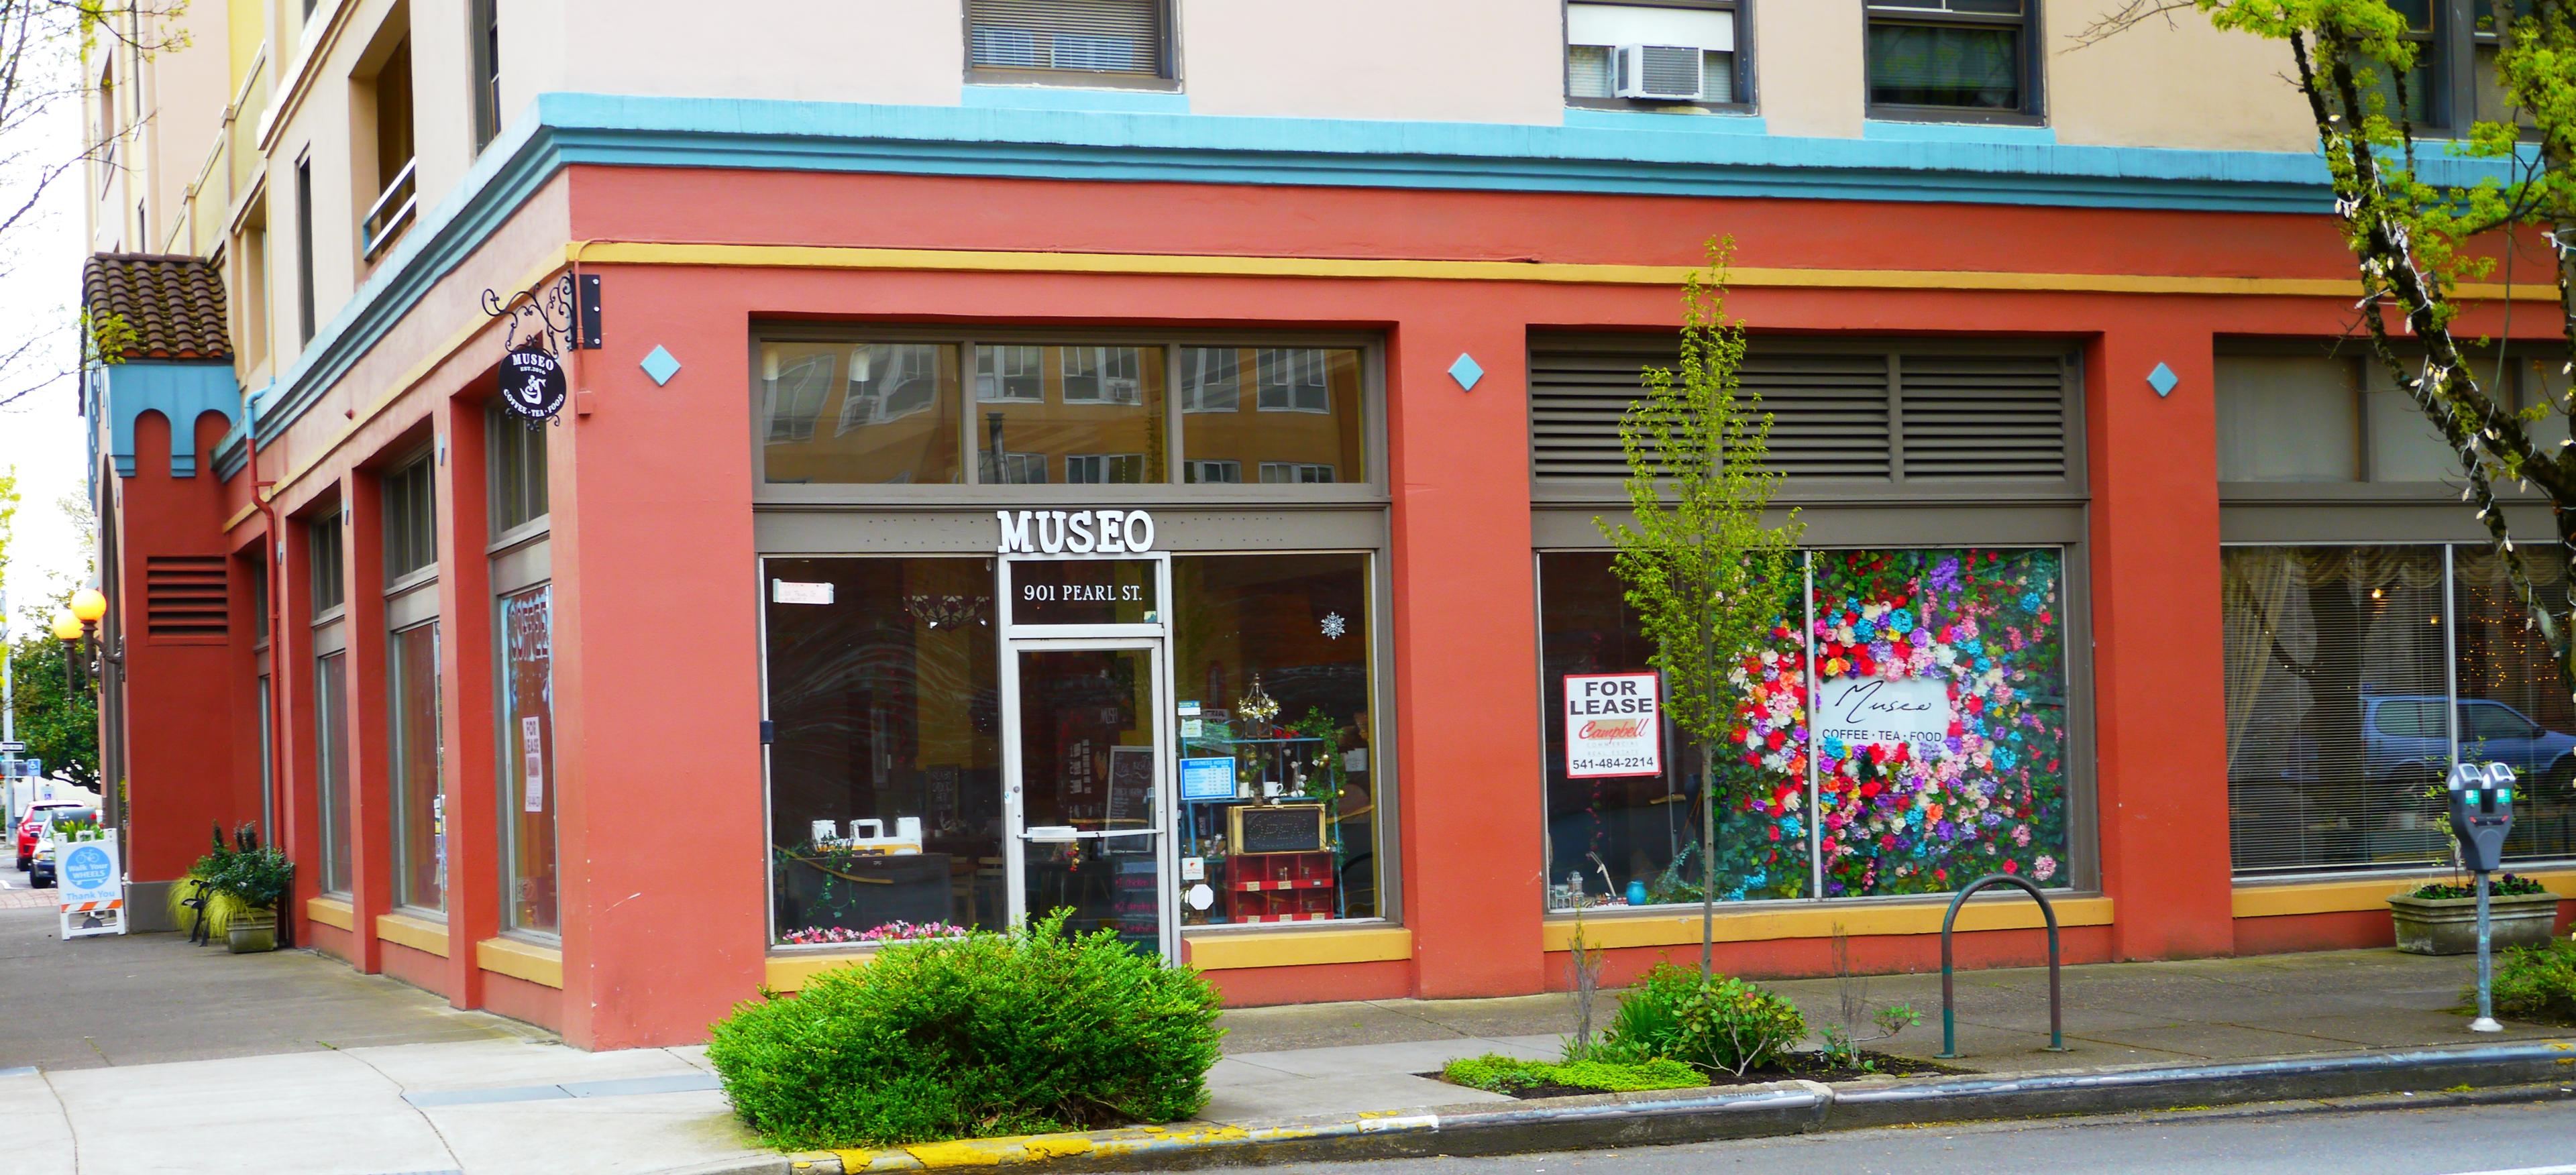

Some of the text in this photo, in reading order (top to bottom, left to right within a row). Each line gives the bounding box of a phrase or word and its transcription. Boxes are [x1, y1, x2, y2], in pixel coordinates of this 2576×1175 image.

[512, 353, 554, 370] MUSEO
[504, 389, 527, 414] COFFEE
[547, 394, 564, 413] FOOD
[997, 510, 1154, 553] MUSEO
[1024, 585, 1142, 600] 901 PEARL ST.
[1585, 681, 1638, 696] FOR
[1570, 698, 1653, 715] LEASE
[1835, 680, 1931, 723] Museo
[1578, 718, 1650, 744] Campbell
[1822, 729, 1941, 742] COFFEE TEA FOOD
[1572, 757, 1654, 769] 541-484-2214
[72, 871, 105, 879] WHEELS
[66, 891, 95, 900] Thank
